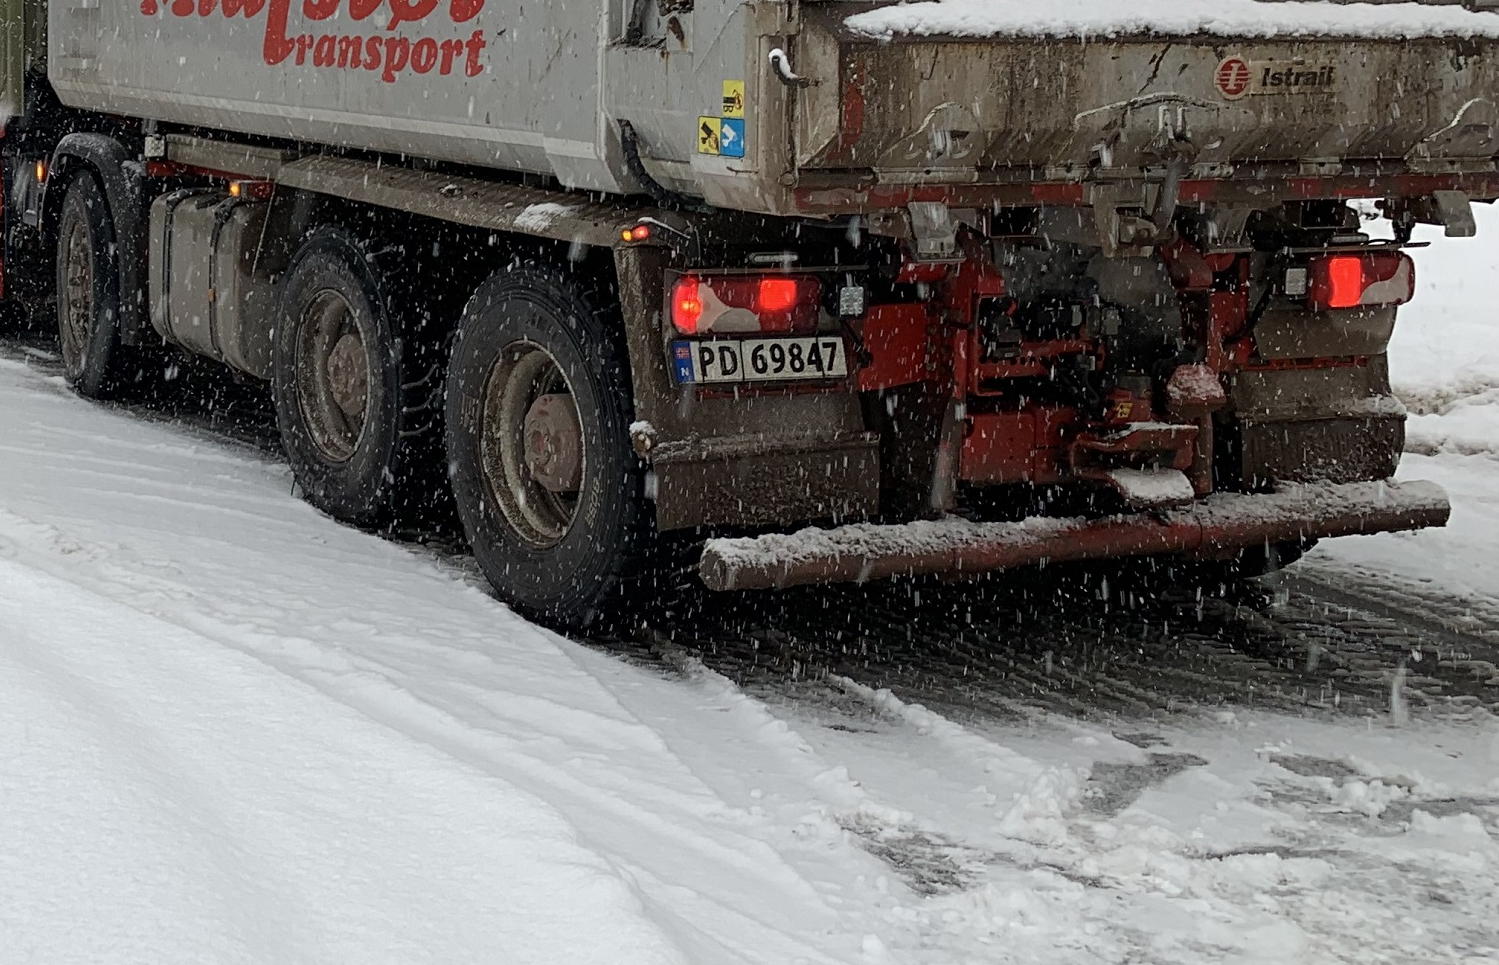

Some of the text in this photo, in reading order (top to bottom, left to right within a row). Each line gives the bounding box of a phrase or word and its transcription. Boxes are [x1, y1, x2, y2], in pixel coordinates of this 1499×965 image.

[1262, 67, 1335, 87] Istrail
[700, 346, 738, 377] PD
[751, 342, 837, 374] 69847
